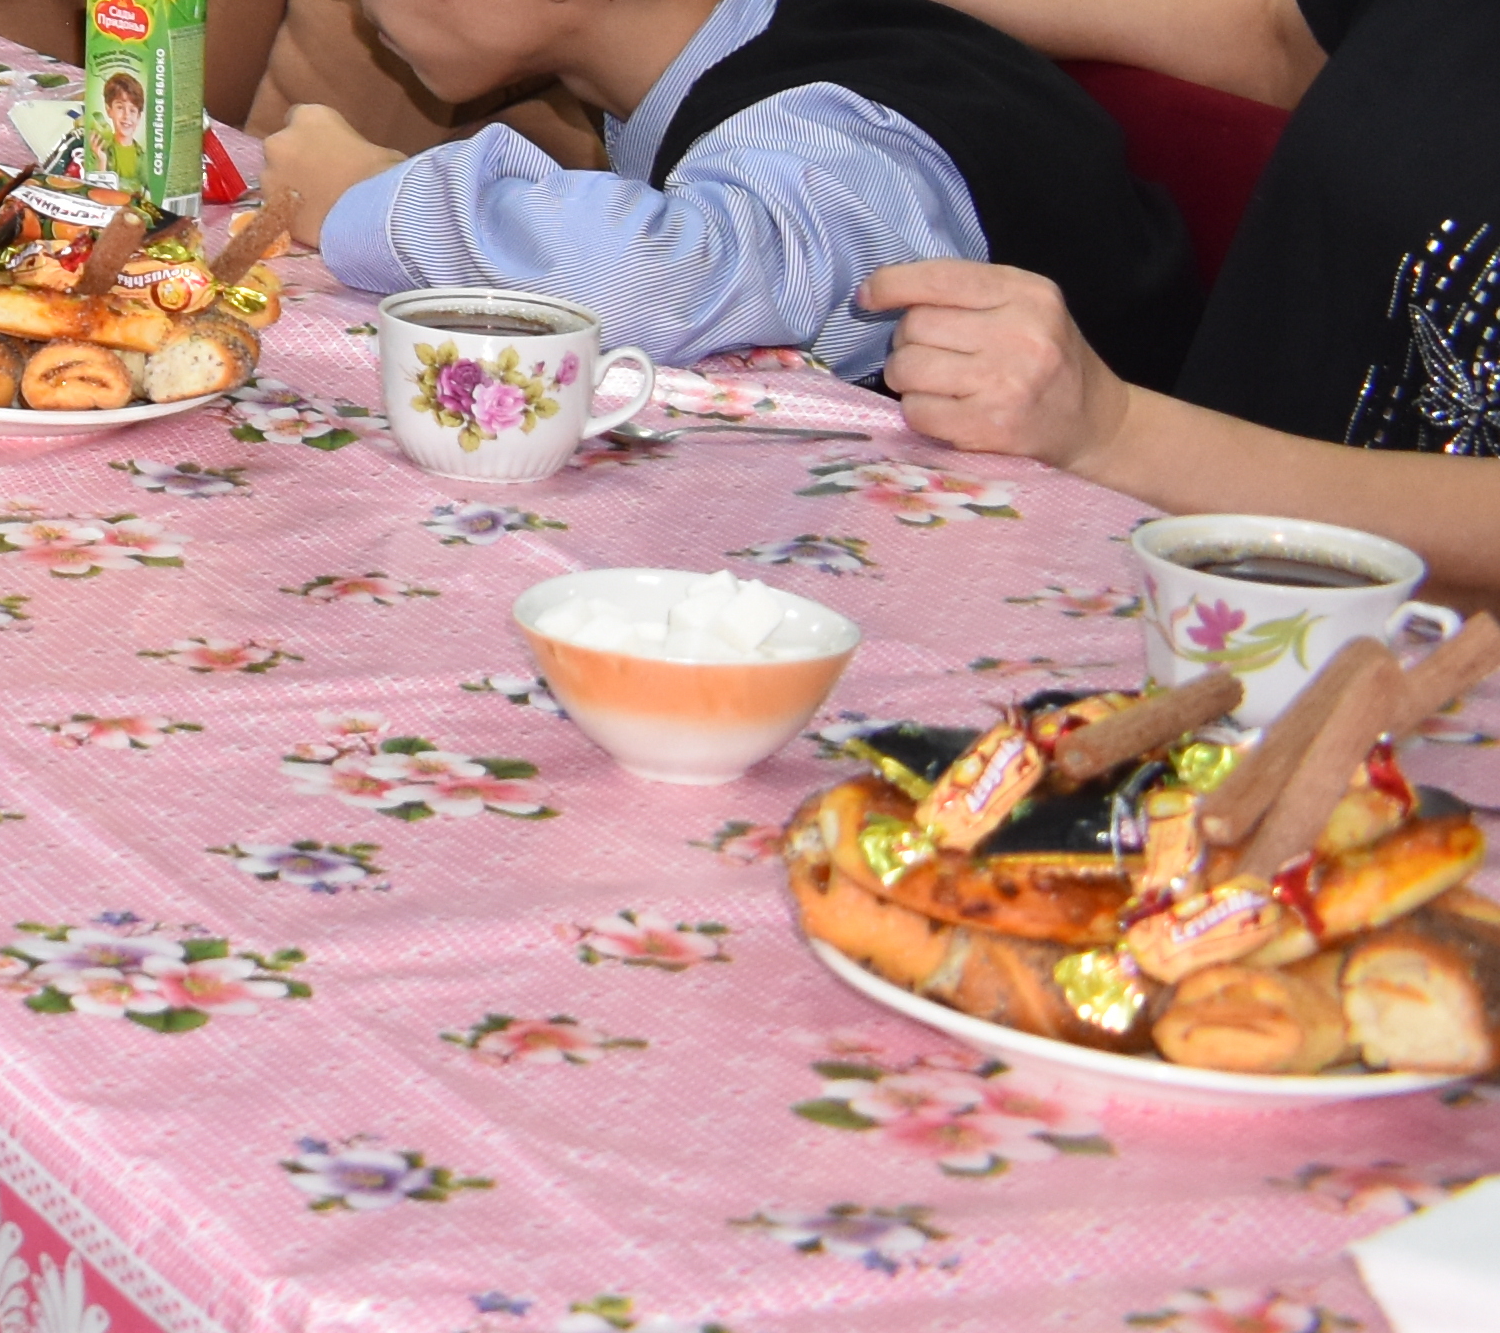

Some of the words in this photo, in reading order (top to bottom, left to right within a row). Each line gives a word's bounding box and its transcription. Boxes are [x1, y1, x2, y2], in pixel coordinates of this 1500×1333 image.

[97, 13, 145, 33] Придонья
[109, 5, 135, 21] Сады
[156, 48, 166, 97] ЯБЛОКО
[154, 98, 165, 148] ЗЕЛЁНОЕ
[154, 151, 163, 176] СОК
